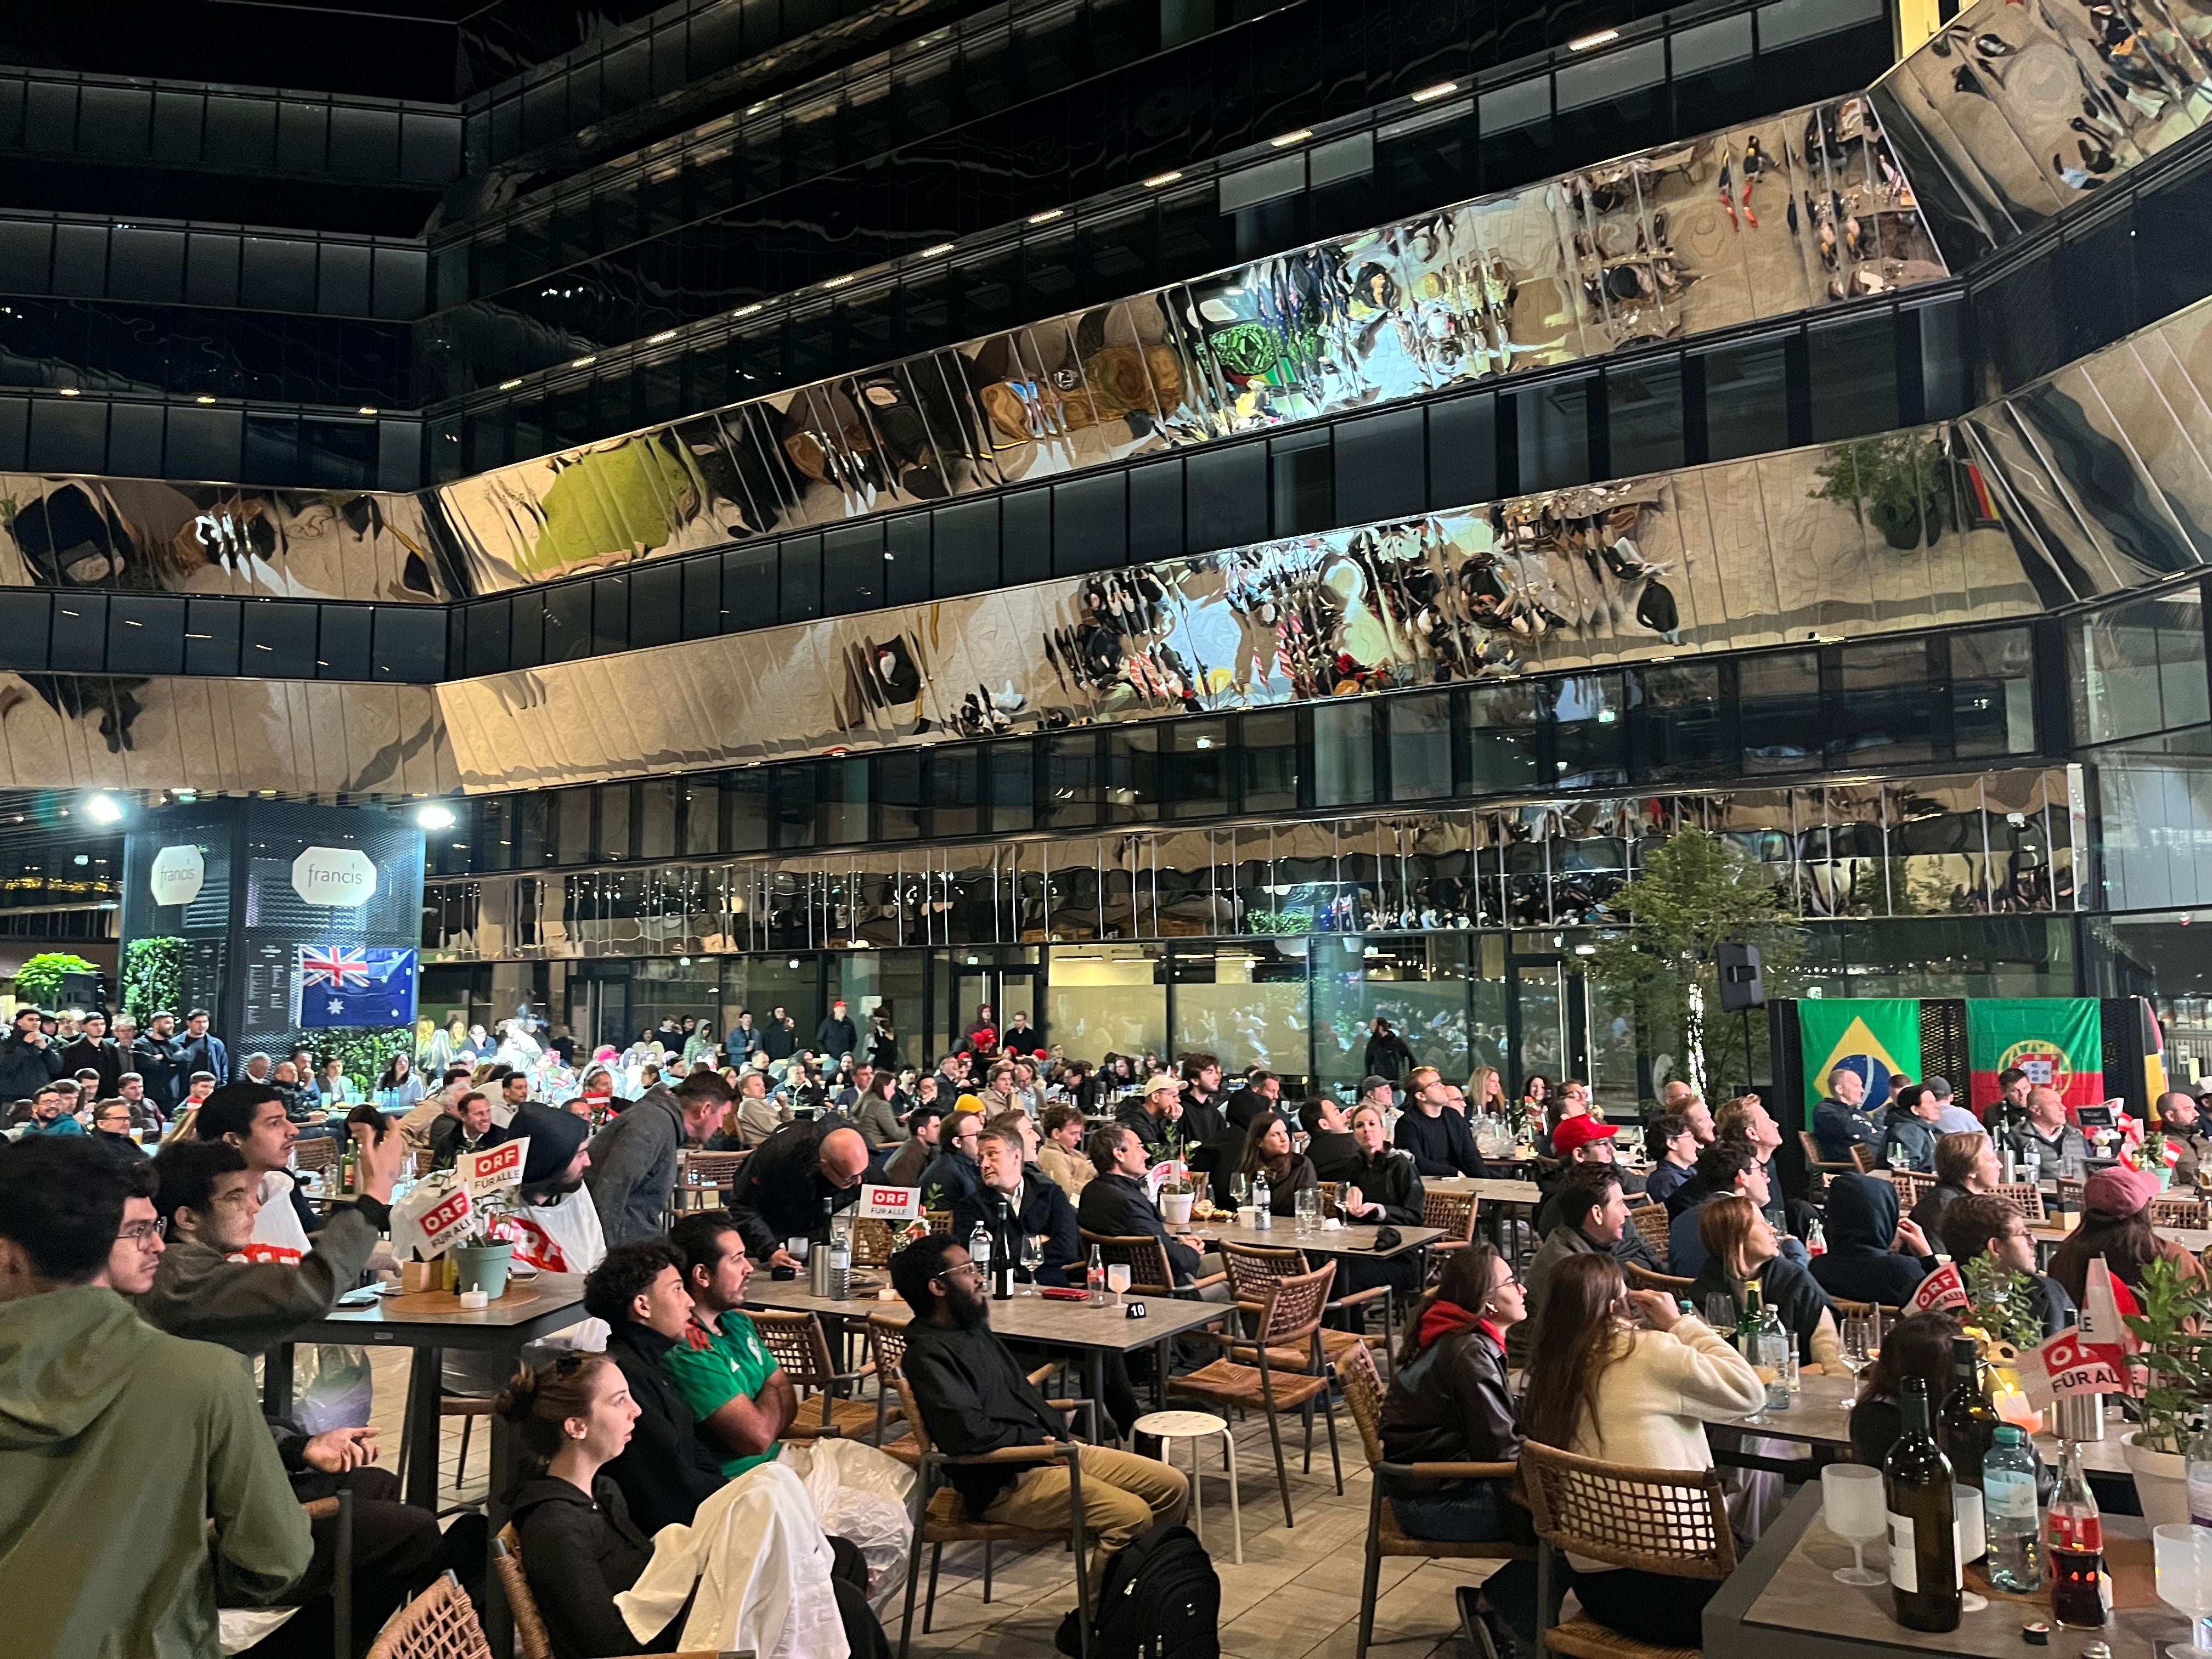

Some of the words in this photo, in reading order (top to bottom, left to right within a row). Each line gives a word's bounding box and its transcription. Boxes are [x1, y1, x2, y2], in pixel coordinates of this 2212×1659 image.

[160, 858, 195, 889] francis
[308, 863, 363, 888] francis
[478, 1149, 516, 1172] ORF
[474, 1177, 495, 1189] FÜR
[495, 1170, 520, 1183] ALLE
[874, 1192, 907, 1204] ORF
[425, 1197, 466, 1230] ORF
[1919, 1274, 1953, 1306] ORF
[1131, 1304, 1145, 1317] 10
[2051, 1372, 2092, 1392] FÜR
